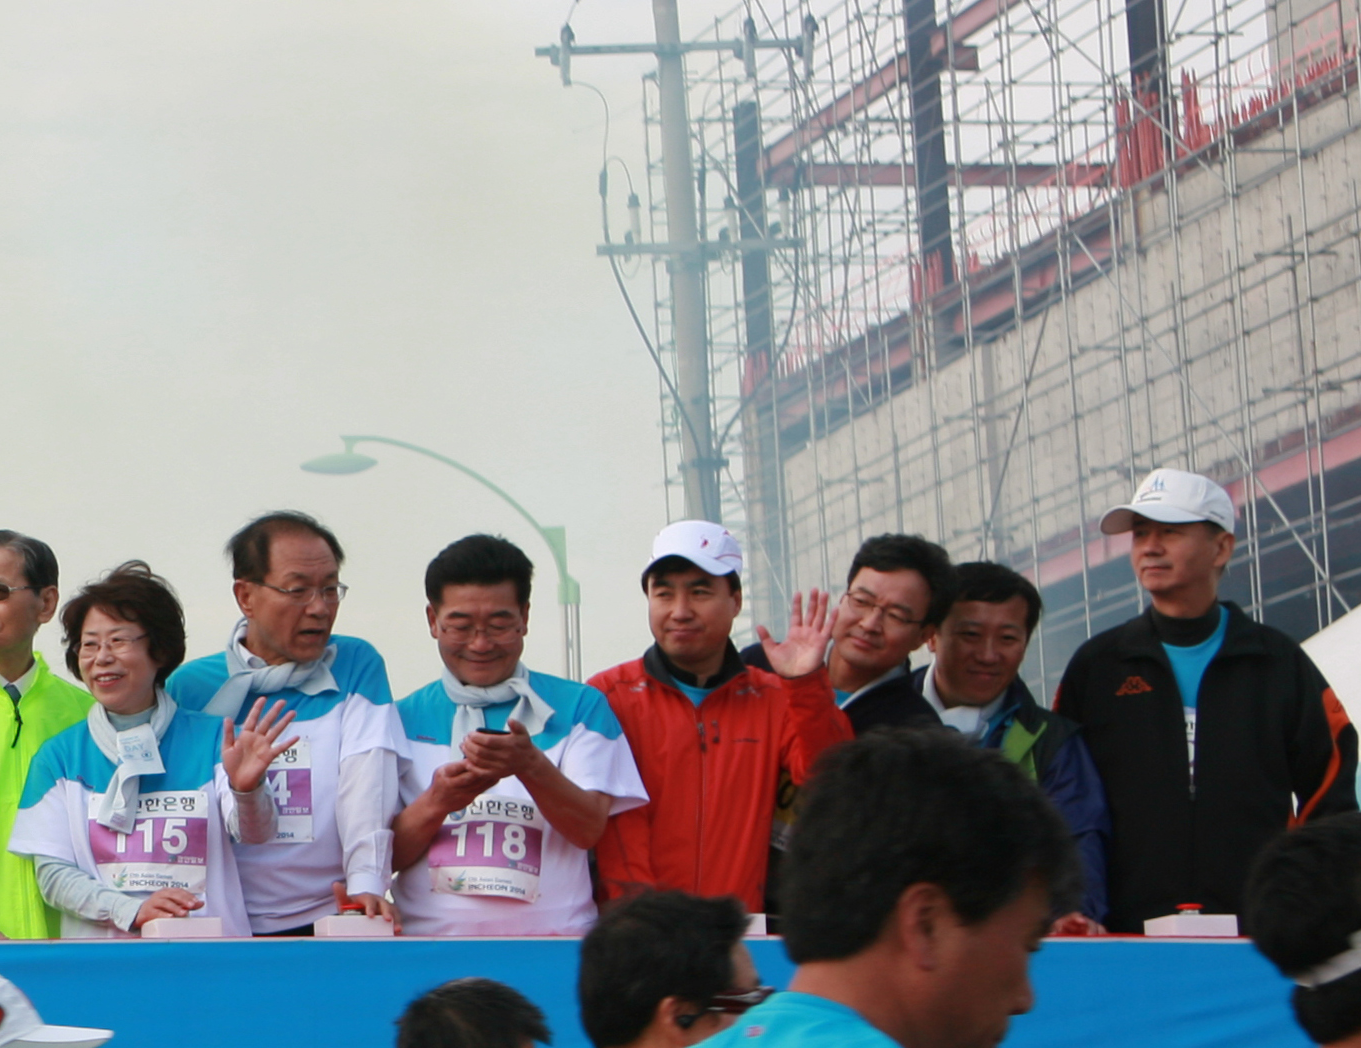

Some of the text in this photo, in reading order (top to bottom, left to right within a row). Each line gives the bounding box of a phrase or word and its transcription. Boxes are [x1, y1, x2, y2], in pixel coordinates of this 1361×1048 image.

[470, 799, 535, 821] 신한은행
[108, 818, 188, 855] 115
[451, 821, 527, 861] 118
[129, 879, 169, 888] INCHEON
